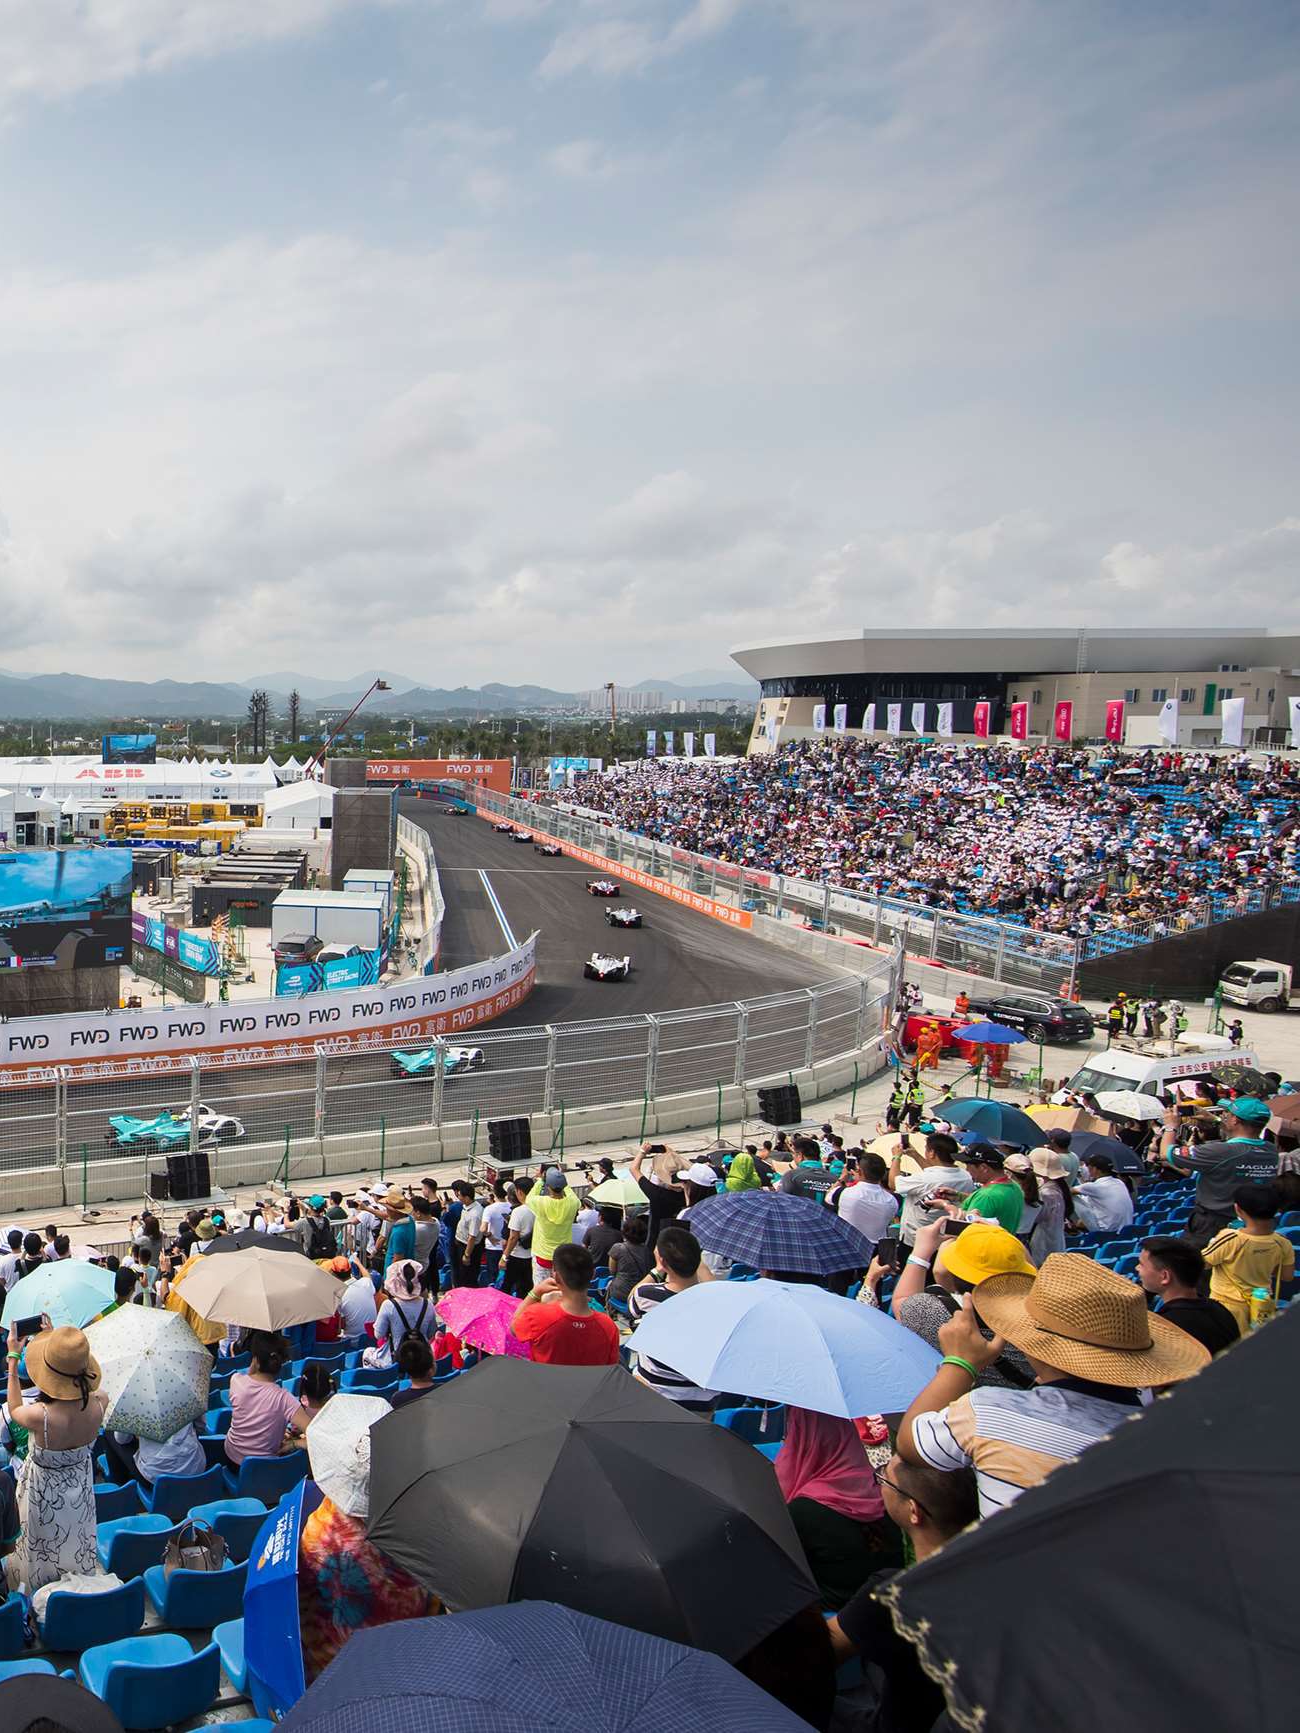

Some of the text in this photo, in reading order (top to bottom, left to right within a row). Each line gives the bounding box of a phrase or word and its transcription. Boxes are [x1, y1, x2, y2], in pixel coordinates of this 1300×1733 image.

[75, 768, 145, 779] ABB
[446, 764, 472, 774] FWD
[8, 1034, 49, 1051] FWD
[71, 1029, 110, 1046] FWD
[119, 1025, 158, 1042] FWD
[168, 1021, 205, 1038] FWD
[220, 1016, 256, 1033] FWD
[265, 1012, 301, 1029] FWD
[308, 1007, 340, 1024] FWD
[352, 1002, 384, 1018] FWD
[390, 995, 416, 1012] FWD
[422, 989, 447, 1006] FWD
[450, 982, 468, 999] FWD
[472, 976, 492, 992] FWD
[494, 969, 507, 984] FWD
[452, 1007, 475, 1028] FWD
[391, 1022, 421, 1039] FWD
